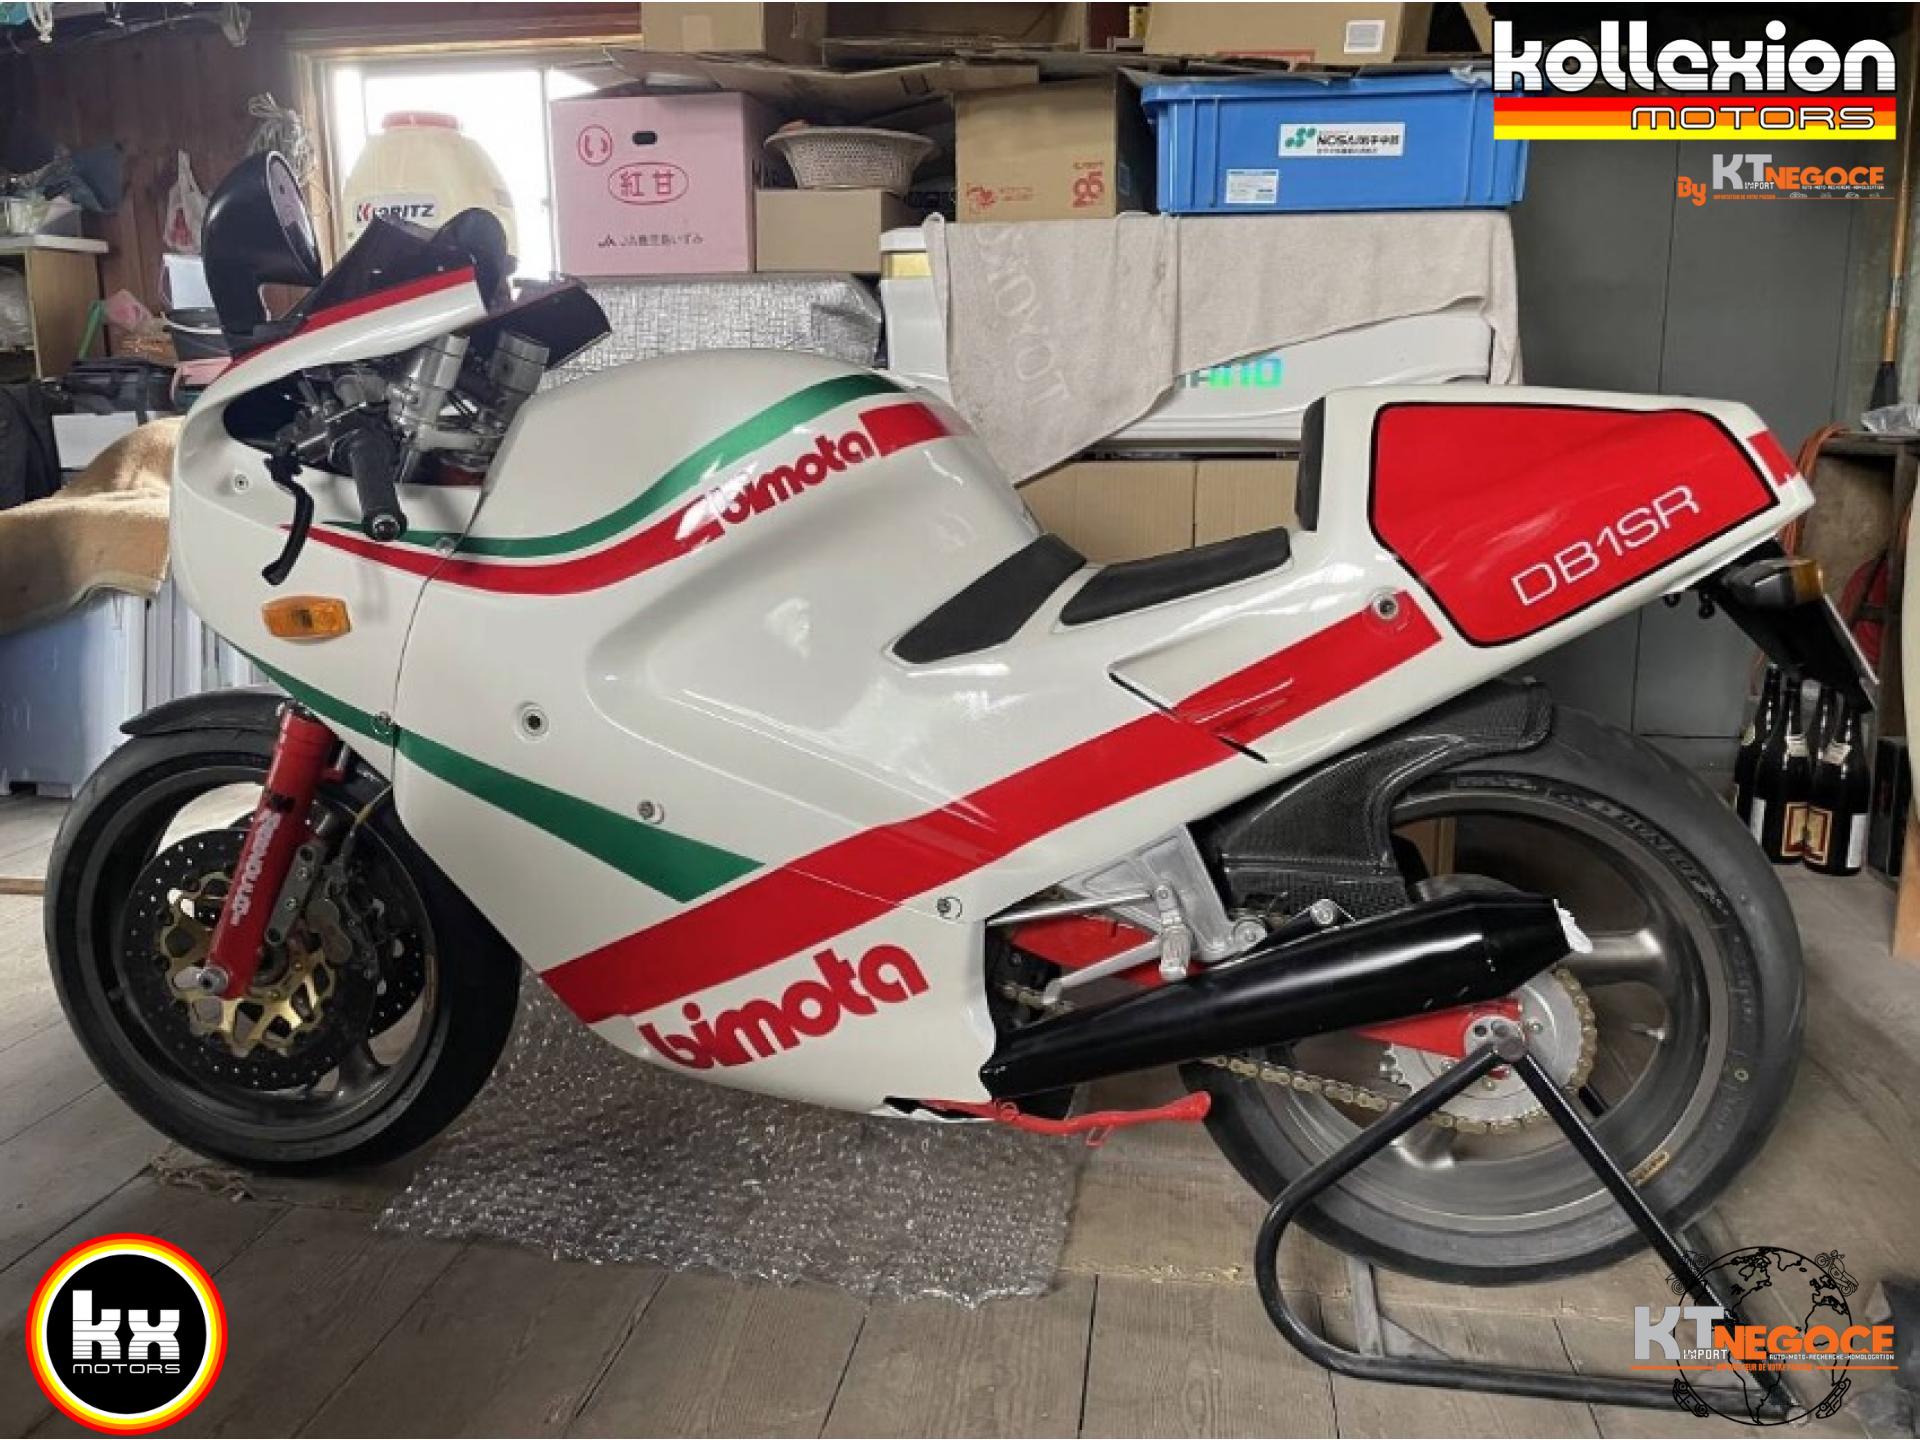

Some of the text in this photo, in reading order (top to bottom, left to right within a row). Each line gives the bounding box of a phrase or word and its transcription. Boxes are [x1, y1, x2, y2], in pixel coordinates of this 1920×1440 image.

[710, 429, 876, 525] bimota
[1511, 485, 1701, 606] DB1SR
[637, 944, 930, 1070] bimota
